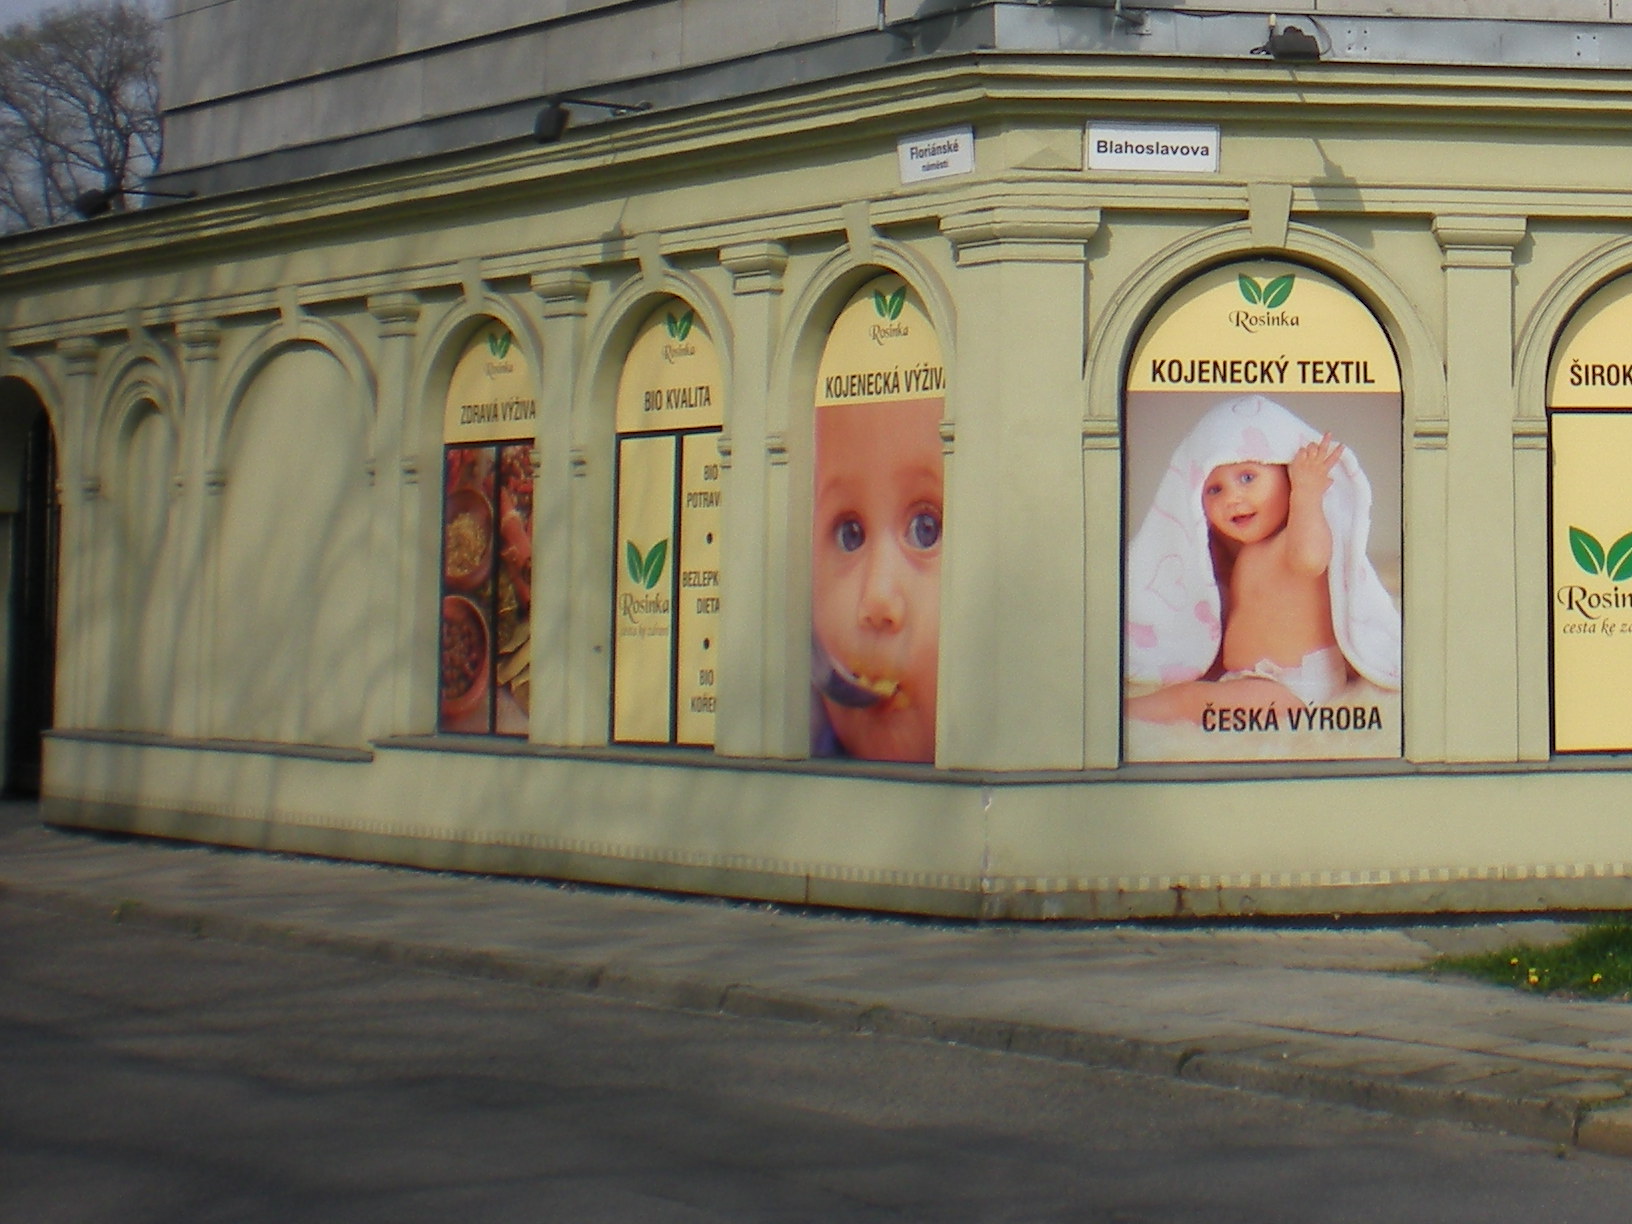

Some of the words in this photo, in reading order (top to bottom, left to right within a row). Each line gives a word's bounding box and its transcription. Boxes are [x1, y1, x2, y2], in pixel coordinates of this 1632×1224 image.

[909, 139, 960, 160] Floriánské
[1096, 139, 1210, 158] Blahoslavova
[1228, 309, 1300, 334] Rosinka
[869, 323, 910, 346] Rosinka
[825, 366, 900, 399] KOJENECKÁ
[904, 363, 946, 393] VÝŽIV
[1151, 354, 1290, 384] KOJENECKÝ
[1297, 360, 1375, 385] TEXTIL
[460, 398, 499, 425] ZDRAVÁ
[501, 395, 536, 422] VÝŽIVA
[644, 391, 663, 412] BIO
[666, 386, 712, 410] KVALITA
[704, 464, 719, 480] BIO
[686, 491, 720, 509] POTRAV
[682, 570, 720, 588] BEZLEPK
[619, 592, 670, 624] Rosinka
[1562, 621, 1597, 635] cesta
[699, 669, 715, 686] BIO
[1201, 702, 1279, 733] ČESKÁ
[1287, 701, 1382, 732] VÝROBA
